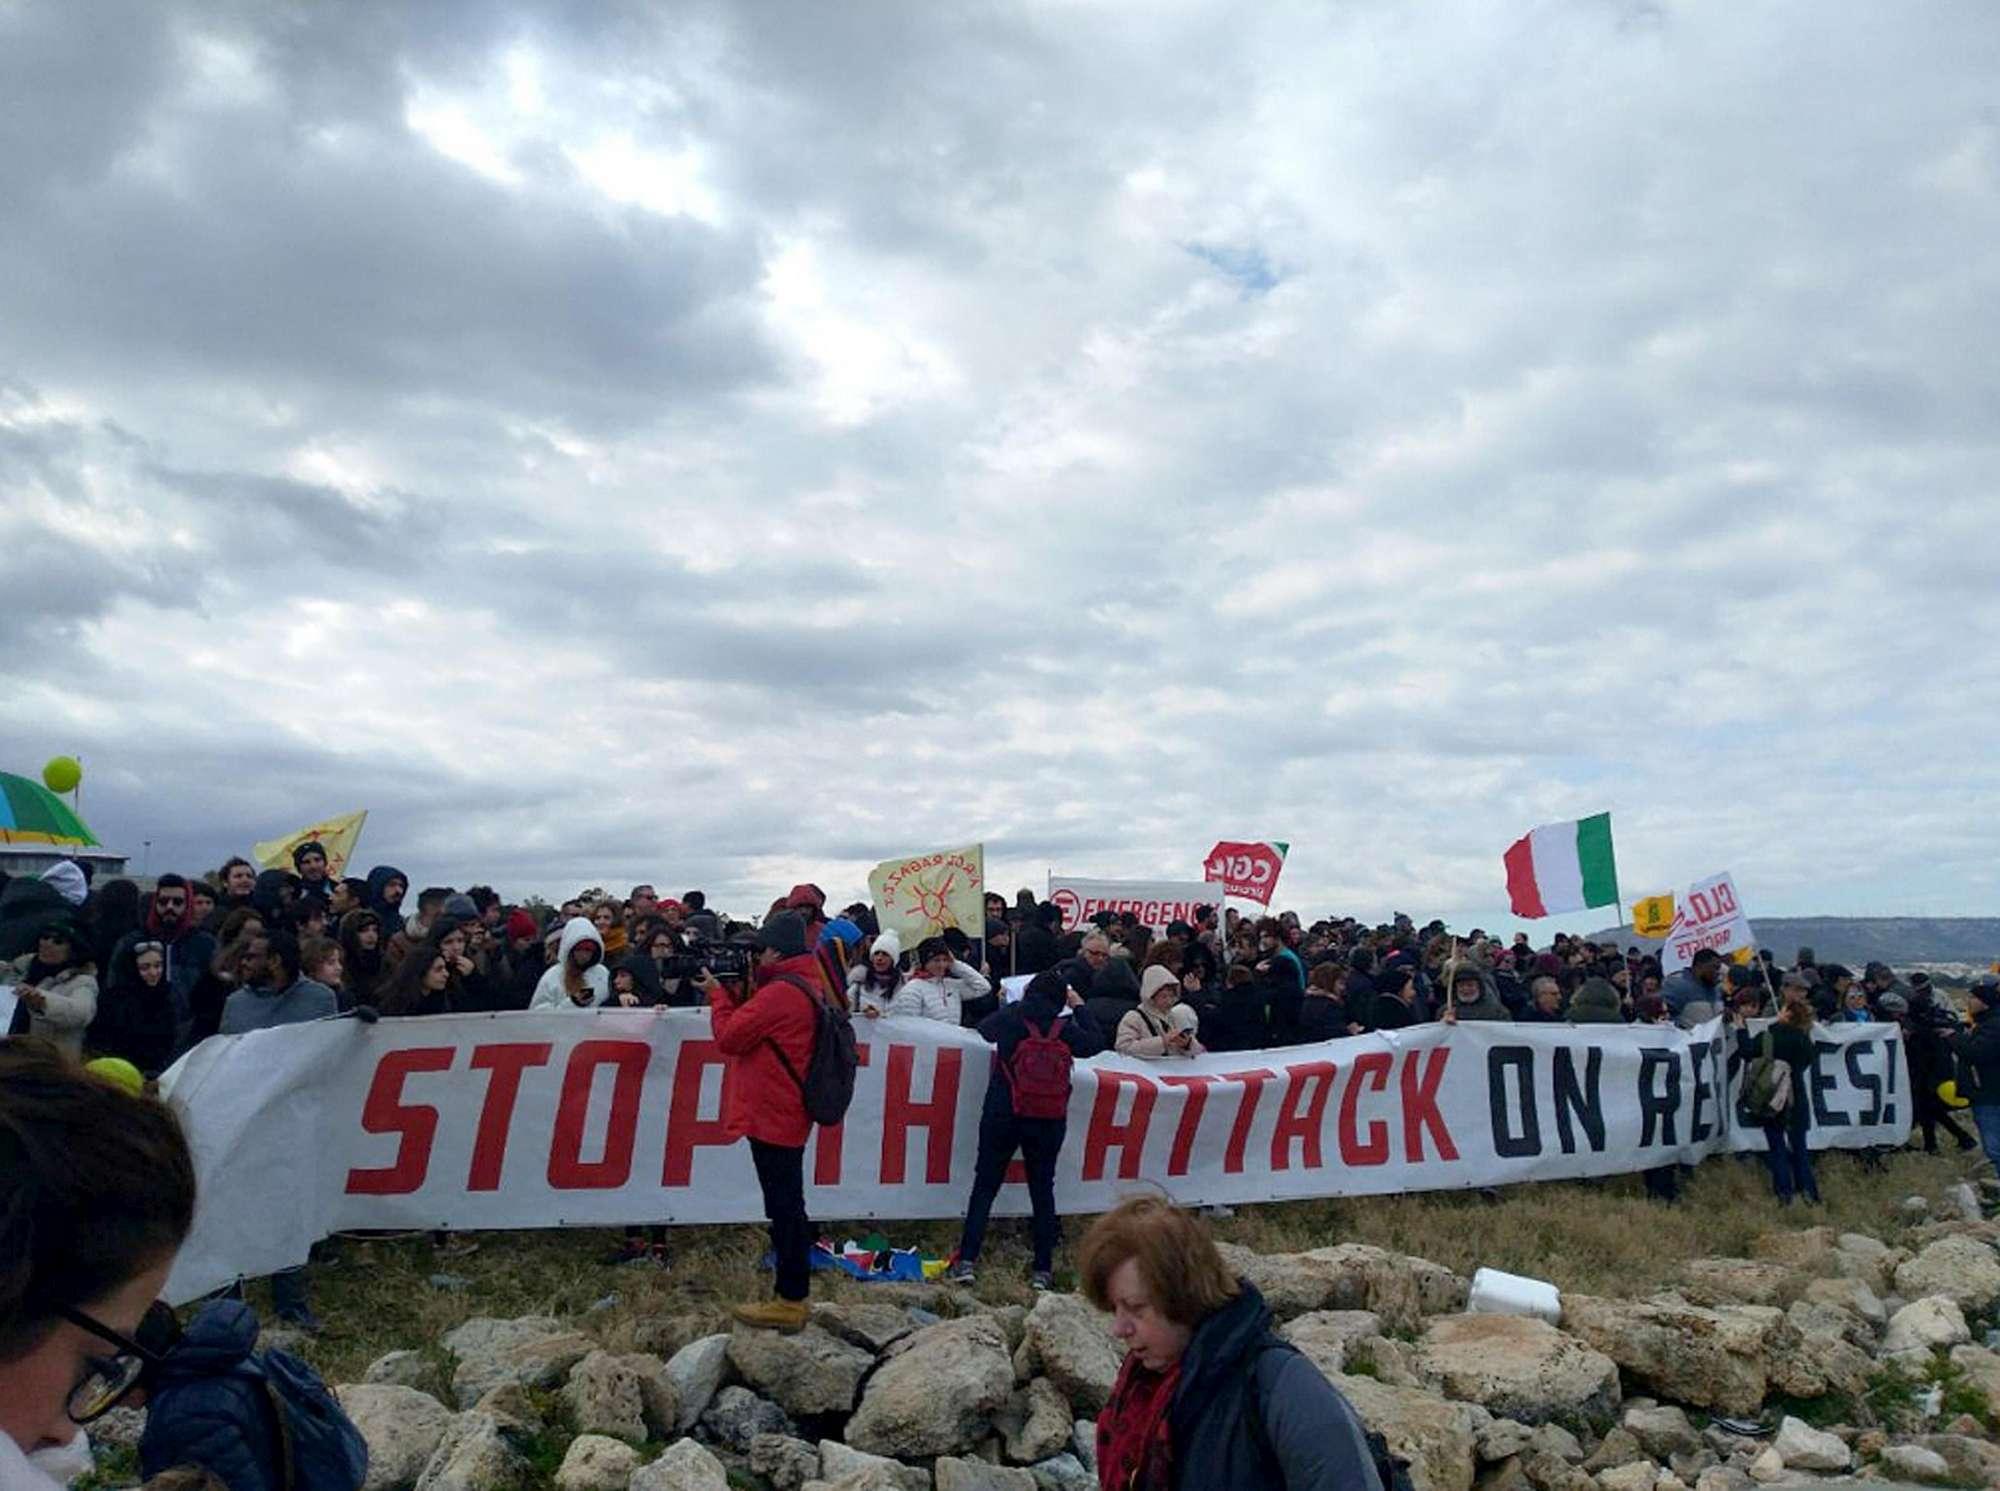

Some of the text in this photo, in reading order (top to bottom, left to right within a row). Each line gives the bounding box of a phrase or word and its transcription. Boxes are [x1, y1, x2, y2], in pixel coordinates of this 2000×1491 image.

[345, 1039, 746, 1194] STOP
[1081, 1046, 1459, 1181] ATTACK
[1488, 1045, 1607, 1158] ON
